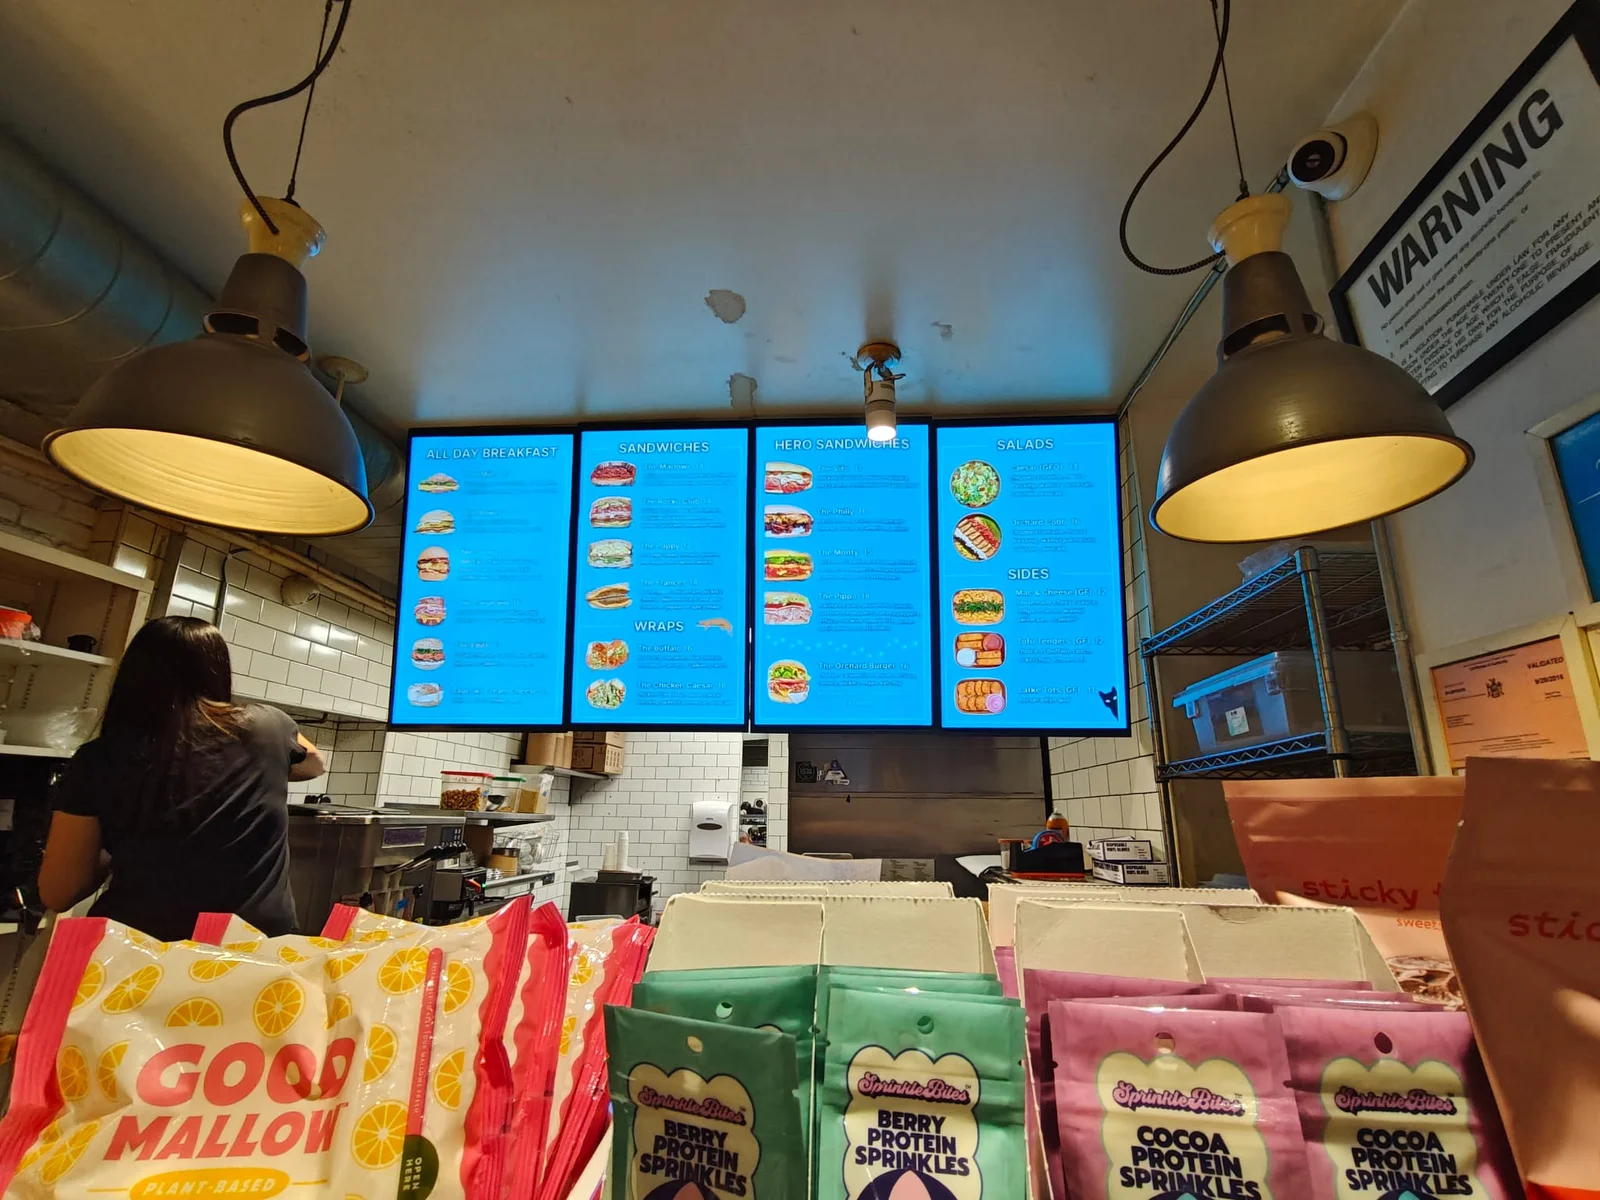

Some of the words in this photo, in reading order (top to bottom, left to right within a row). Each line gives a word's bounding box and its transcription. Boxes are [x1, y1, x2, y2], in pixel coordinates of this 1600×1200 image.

[1368, 88, 1563, 308] WARNING
[1388, 306, 1404, 324] person
[1405, 294, 1416, 307] shall
[1432, 268, 1443, 281] give
[1444, 253, 1458, 268] away
[1459, 242, 1469, 253] any
[1497, 180, 1532, 215] beverages
[1404, 309, 1421, 327] person
[1422, 293, 1436, 310] under
[1464, 236, 1496, 268] twenty-one
[1521, 204, 1528, 214] or
[1414, 326, 1442, 354] VIOLATION
[1446, 290, 1484, 325] PUNISHABLE
[1487, 265, 1511, 289] UNDER
[1513, 248, 1529, 265] LAW
[1532, 230, 1550, 248] FOR
[1553, 212, 1568, 230] ANY
[1420, 339, 1440, 358] UNDER
[1442, 327, 1453, 338] THE
[1456, 313, 1468, 327] AGE
[1471, 302, 1480, 313] OF
[1531, 248, 1542, 260] TO
[1545, 211, 1582, 248] PRESENT
[1424, 337, 1452, 365] EVIDENCE
[1454, 328, 1462, 338] OF
[1466, 314, 1479, 329] AGE
[1481, 292, 1504, 314] WHICH
[1545, 206, 1599, 259] FRAUDULENT
[1425, 346, 1452, 373] ACTUALLY
[1455, 336, 1466, 347] HIS
[1468, 320, 1484, 336] OWN
[1486, 306, 1501, 320] FOR
[1504, 292, 1518, 306] THE
[1520, 255, 1558, 292] PURPOSE
[1560, 244, 1572, 258] OF
[1449, 327, 1483, 362] PURCHASE
[1486, 318, 1498, 333] ANY
[1502, 277, 1544, 319] ALCOHOLIC
[426, 448, 450, 460] ALL
[453, 448, 479, 459] DAY
[482, 446, 558, 458] BREAKFAST
[619, 442, 710, 454] SANDWICHES
[775, 439, 812, 451] HERO
[816, 438, 910, 450] SANDWICHES
[997, 438, 1054, 450] SALADS
[833, 508, 854, 516] Philly
[834, 549, 859, 557] Monty
[1008, 568, 1050, 580] SIDES
[1044, 588, 1072, 596] Cheese
[1075, 588, 1092, 597] (GF)
[634, 620, 684, 632] WRAPS
[638, 644, 651, 652] The
[654, 644, 680, 652] Buffalo
[1072, 637, 1090, 646] (GF)
[818, 662, 832, 670] The
[835, 662, 867, 670] Orchard
[869, 662, 896, 672] Burger
[1527, 656, 1564, 670] VALIDATED
[1018, 686, 1040, 694] Latke
[1044, 686, 1061, 694] Tots
[1064, 686, 1081, 695] (GF)
[1303, 877, 1418, 911] sticky
[1396, 918, 1442, 930] sweet
[136, 1037, 356, 1106] GOOD
[416, 1051, 427, 1087] MALLOWS
[414, 1089, 422, 1113] FRESH
[663, 1119, 728, 1148] BERRY
[878, 1110, 946, 1134] BERRY
[653, 1134, 738, 1172] PROTEIN
[867, 1128, 957, 1155] PROTEIN
[1137, 1126, 1230, 1154] COCOA
[1356, 1128, 1445, 1153] COCOA
[402, 1158, 414, 1192] HERE
[412, 1156, 423, 1190] OPEN
[639, 1152, 747, 1196] SPRINKLES
[854, 1146, 970, 1176] SPRINKLES
[1131, 1146, 1243, 1179] PROTEIN
[1352, 1147, 1457, 1175] PROTEIN
[141, 1178, 279, 1198] PLANT-BASED
[1119, 1166, 1262, 1200] SPRINKLES
[1346, 1168, 1473, 1197] SPRINKLES
